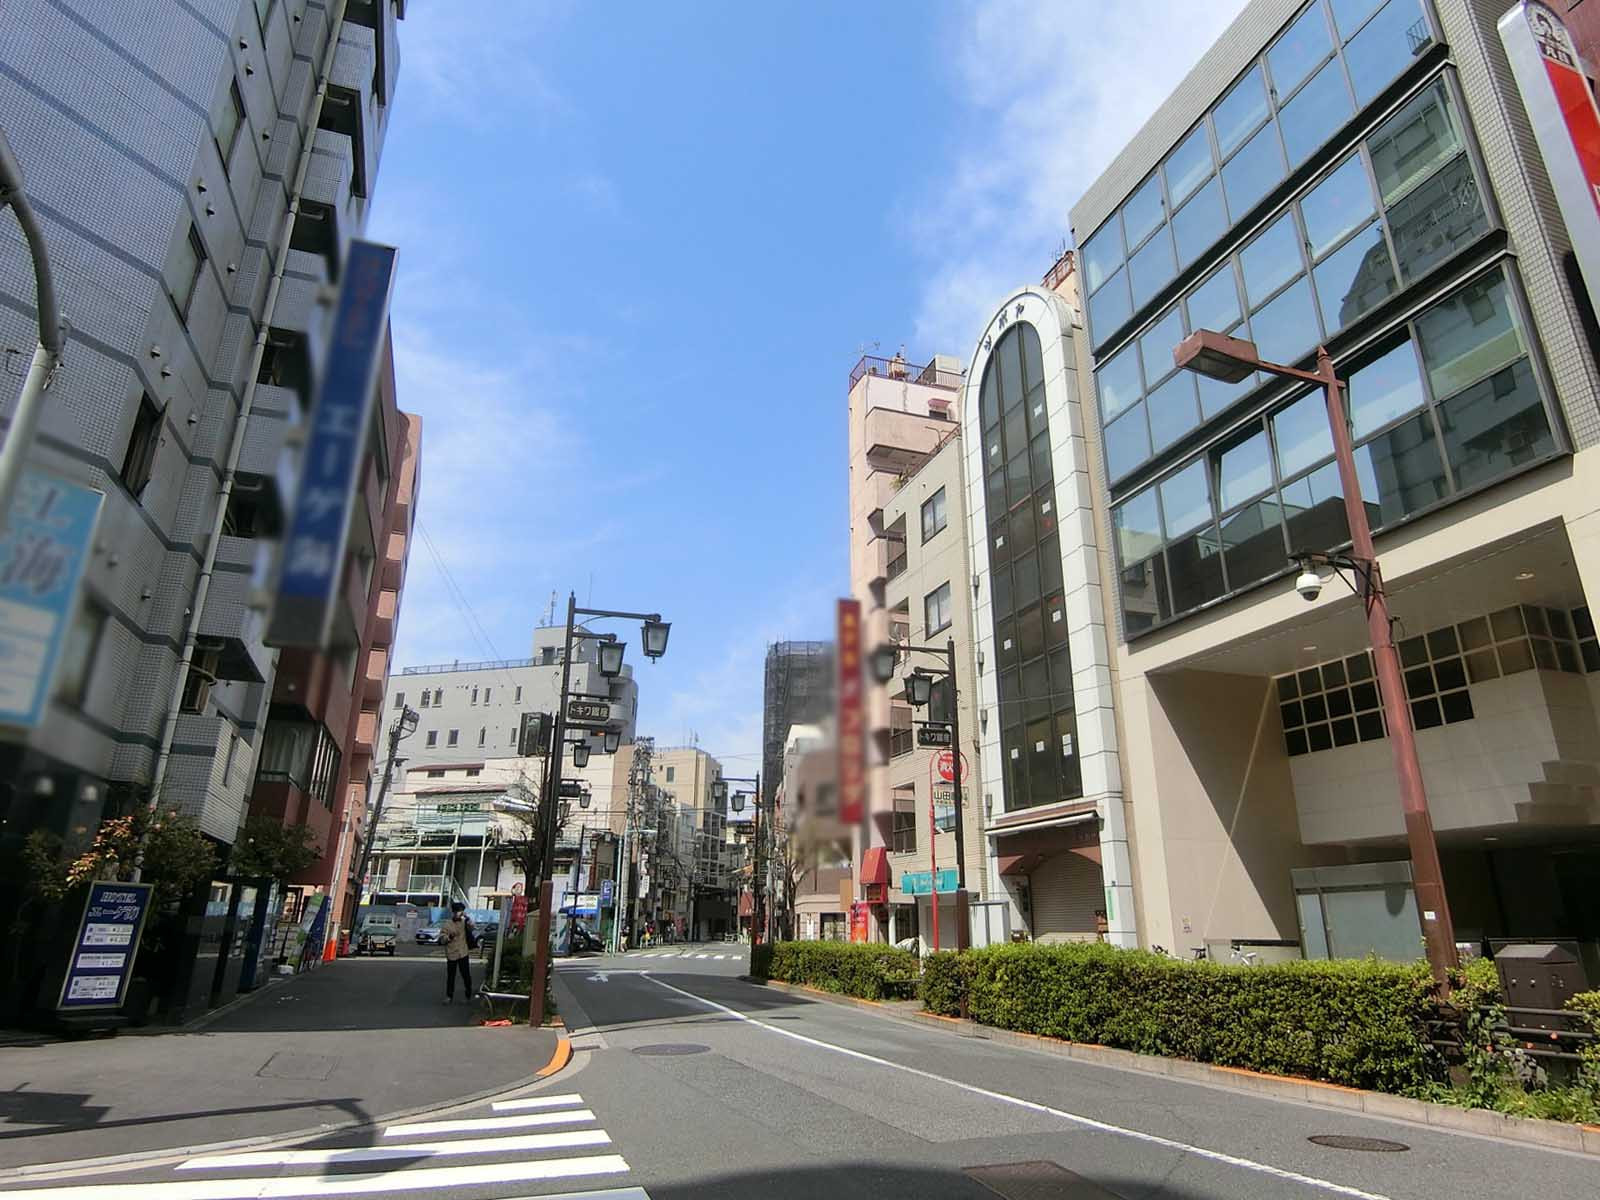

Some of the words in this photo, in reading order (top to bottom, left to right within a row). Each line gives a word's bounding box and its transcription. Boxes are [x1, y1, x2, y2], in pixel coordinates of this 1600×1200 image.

[570, 704, 609, 718] トキワ銀座
[100, 891, 137, 903] HOTEL
[88, 905, 140, 920] エーゲ海
